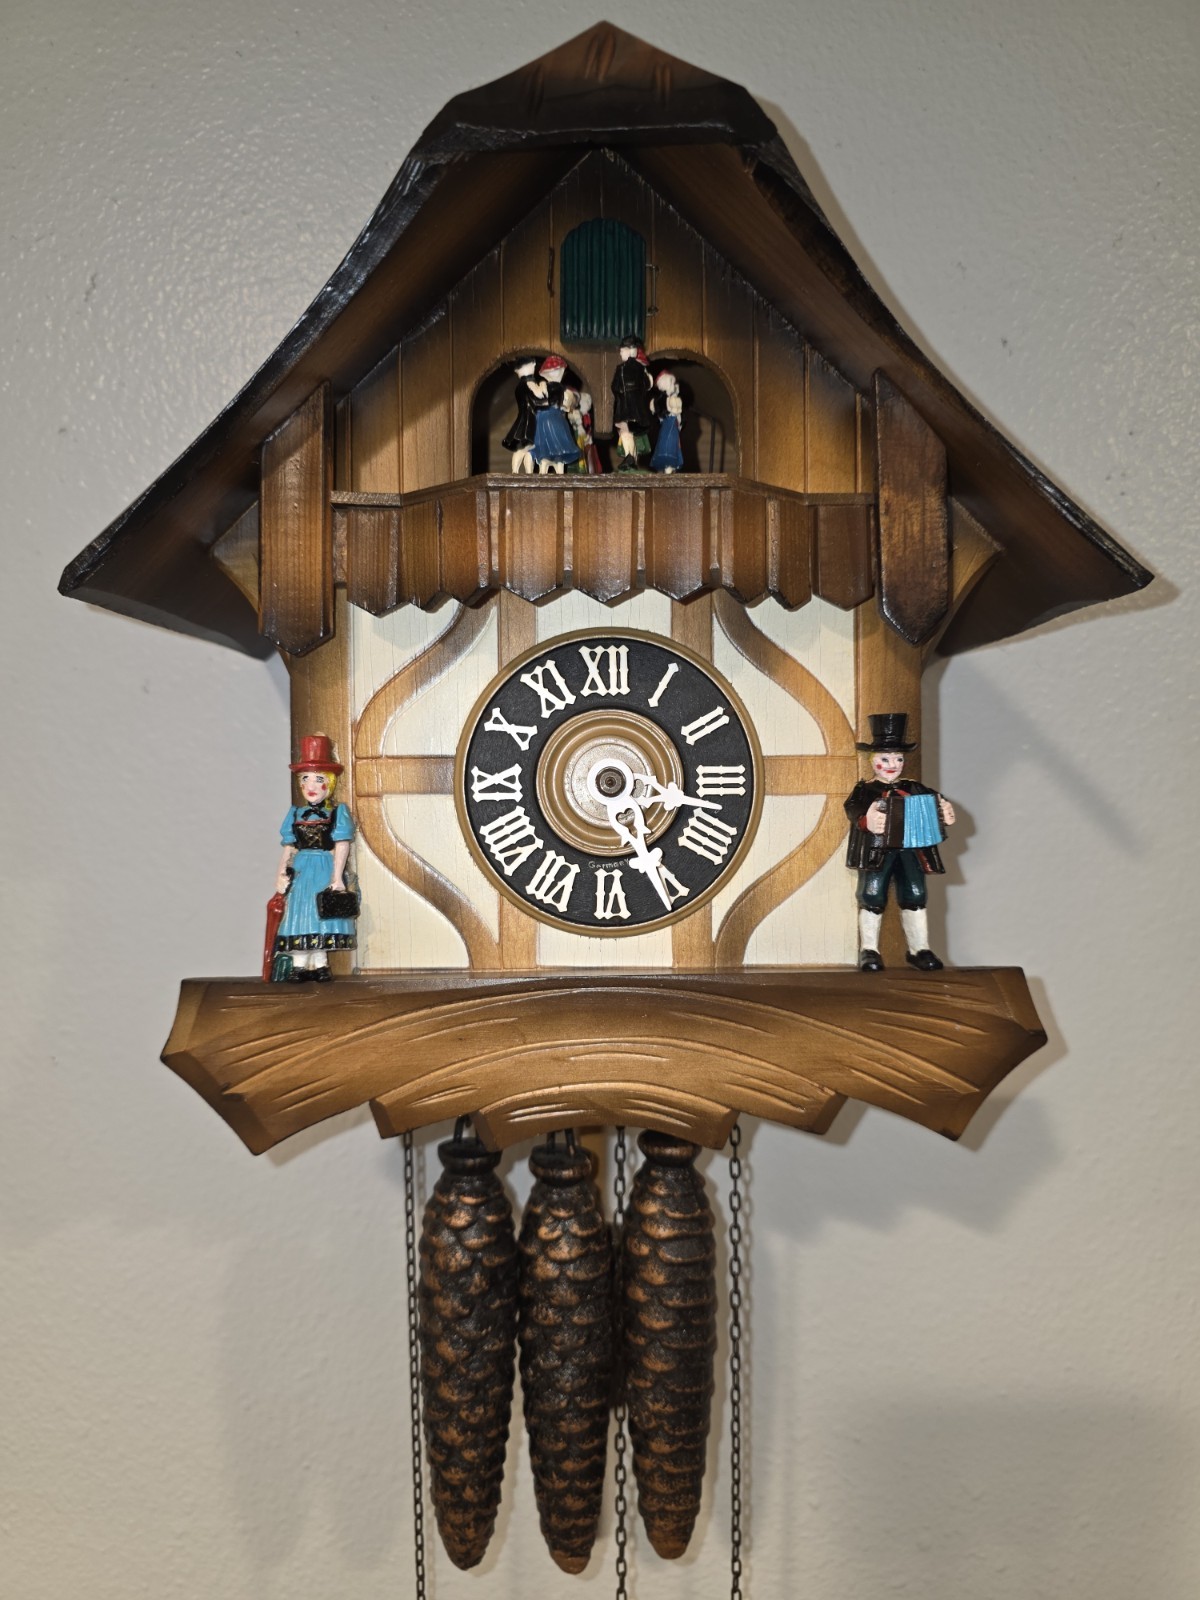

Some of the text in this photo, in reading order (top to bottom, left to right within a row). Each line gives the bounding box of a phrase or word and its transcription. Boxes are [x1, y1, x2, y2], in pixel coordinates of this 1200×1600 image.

[520, 659, 577, 719] XI
[579, 644, 631, 697] XII
[648, 662, 679, 708] I
[483, 707, 538, 751] X
[681, 705, 730, 746] II
[471, 763, 522, 803] IX
[695, 764, 746, 798] III
[479, 805, 544, 877] VIII
[678, 807, 737, 865] IIII
[525, 850, 580, 913] VII
[593, 868, 632, 920] VI
